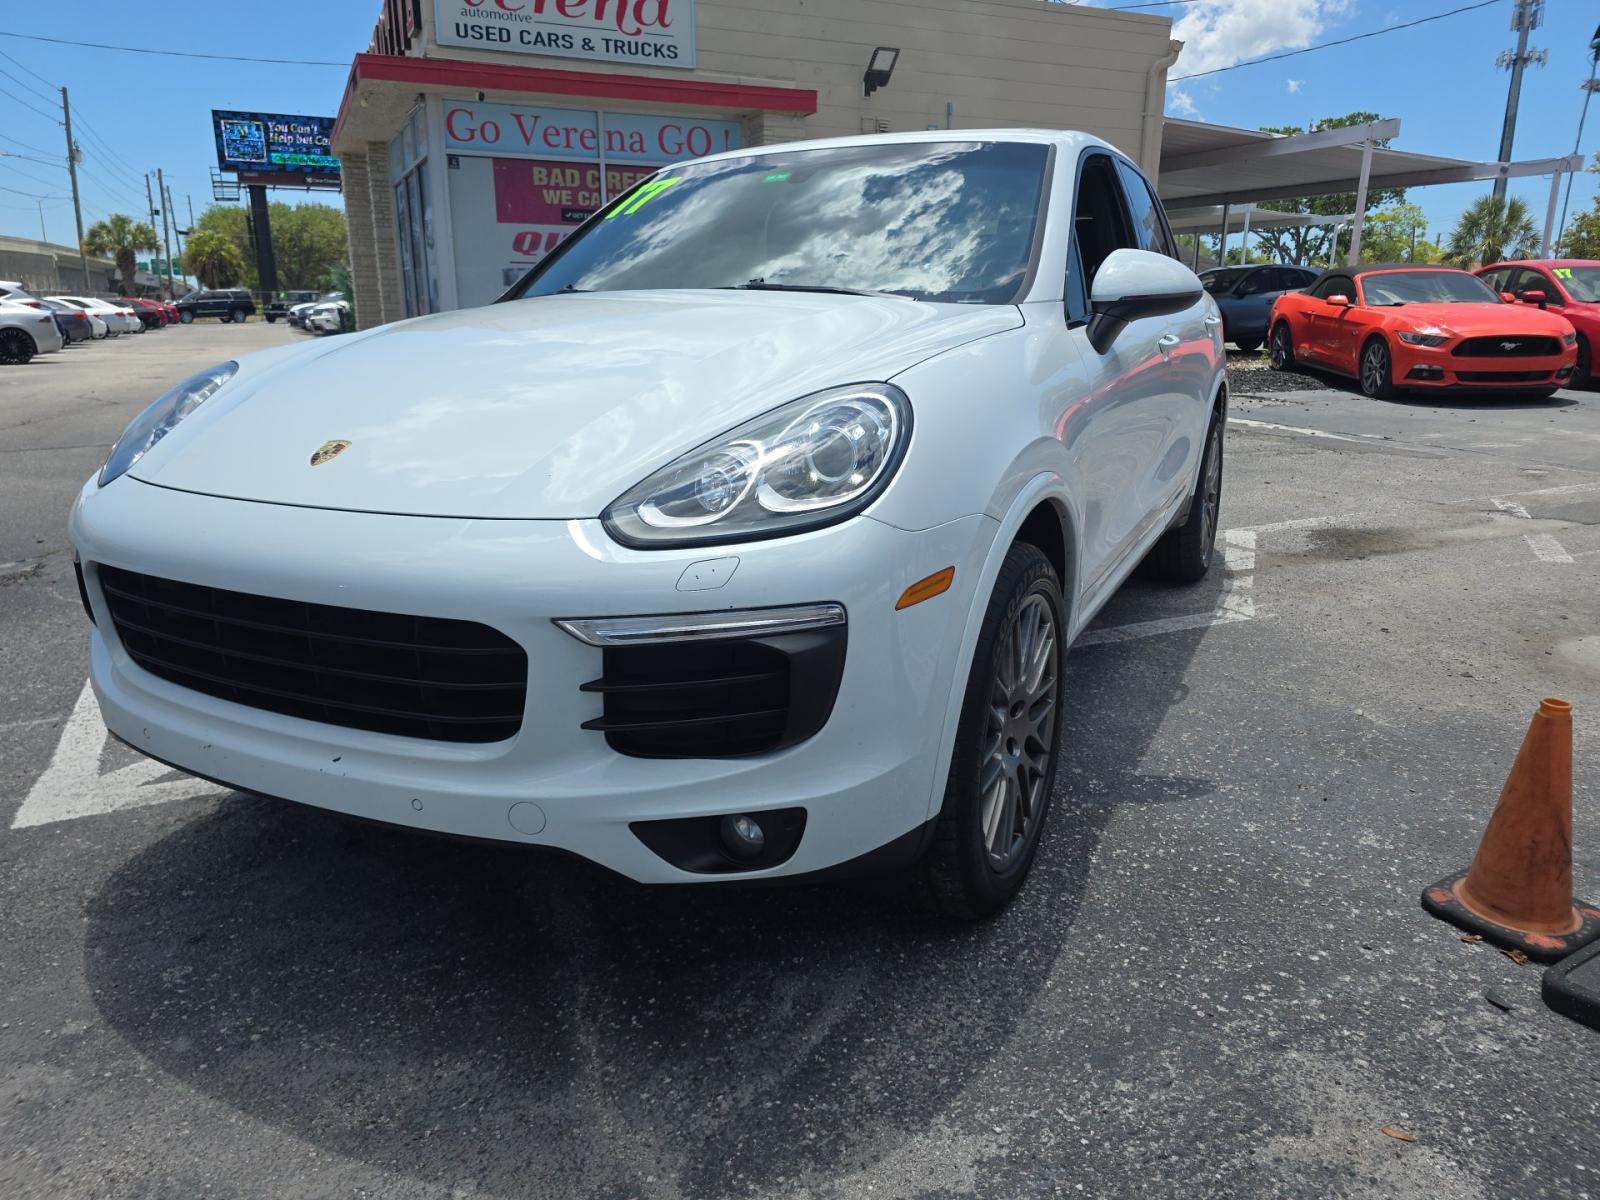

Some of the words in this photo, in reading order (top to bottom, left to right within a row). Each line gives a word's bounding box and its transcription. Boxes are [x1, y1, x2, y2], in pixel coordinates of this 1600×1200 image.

[460, 8, 533, 23] automotive
[455, 22, 511, 43] USED
[519, 29, 574, 50] CARS
[581, 37, 595, 52] &
[601, 38, 678, 59] TRUCKS
[267, 121, 288, 133] You
[446, 108, 500, 144] Go
[511, 112, 646, 154] Verena
[658, 124, 712, 157] GO
[268, 132, 294, 145] Help
[532, 166, 581, 188] BAD
[543, 189, 572, 206] WE
